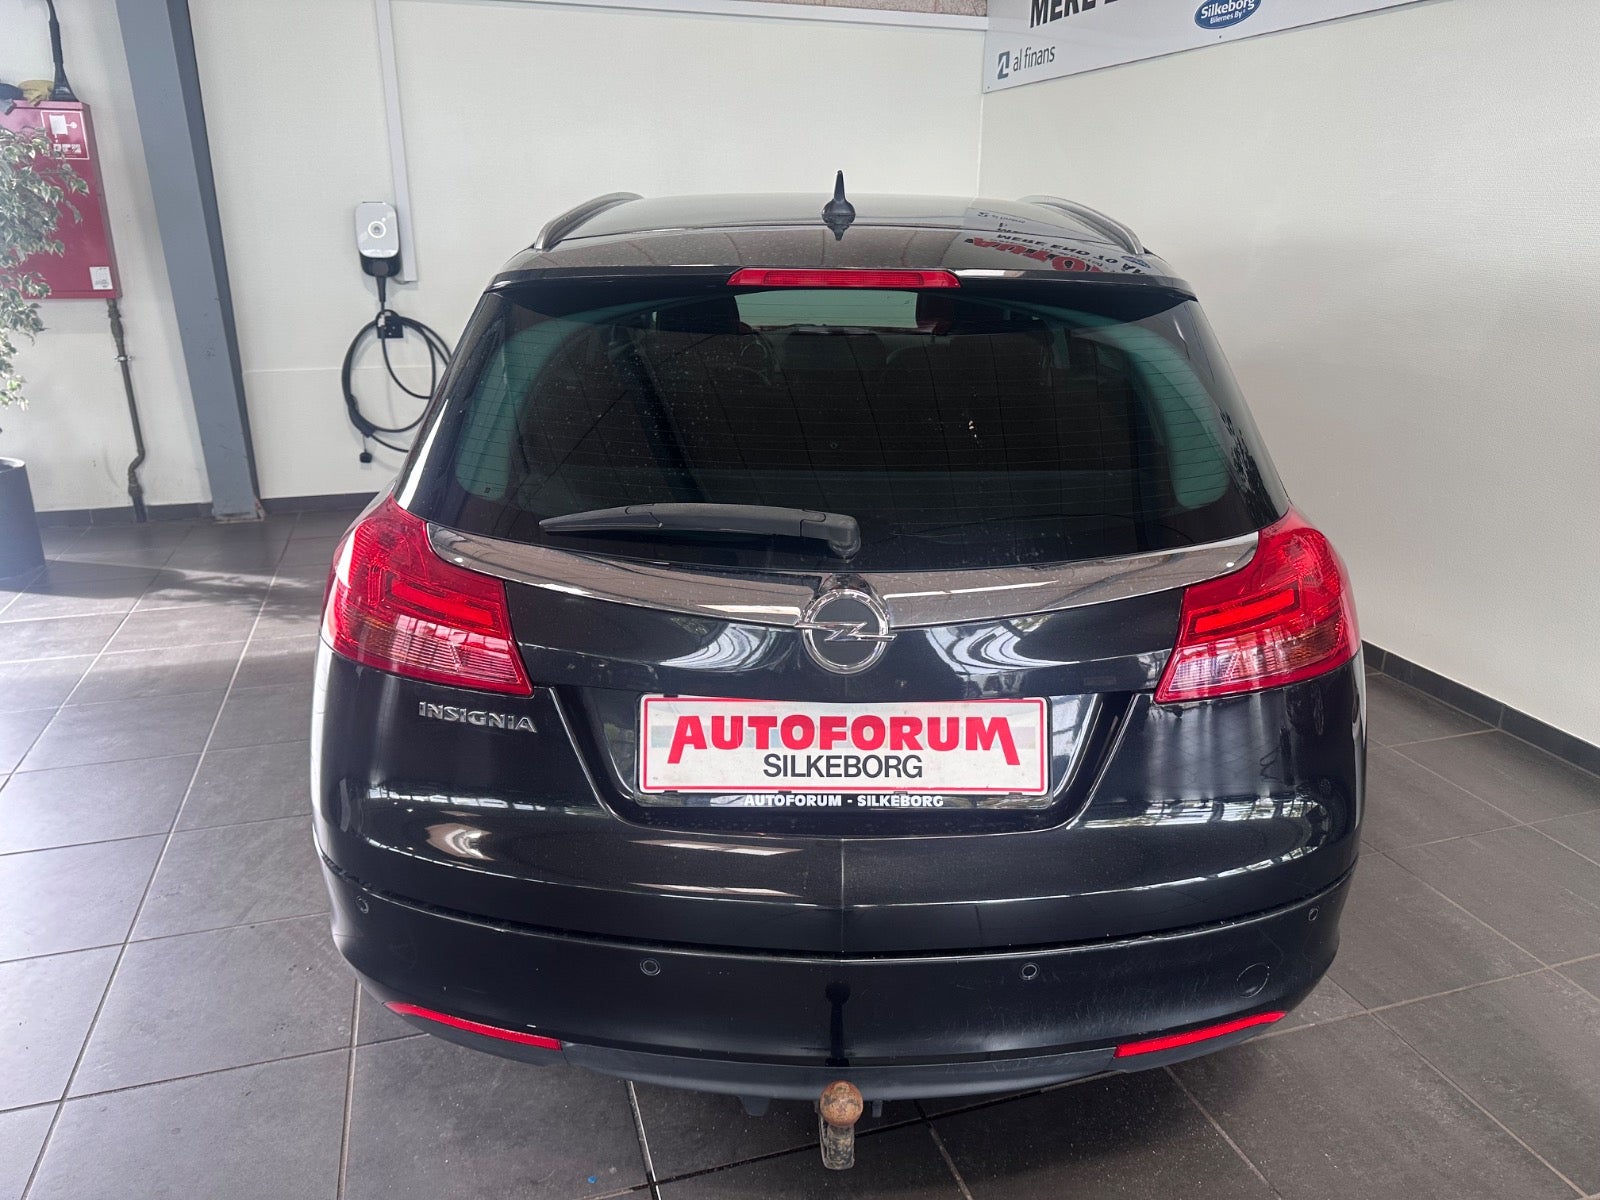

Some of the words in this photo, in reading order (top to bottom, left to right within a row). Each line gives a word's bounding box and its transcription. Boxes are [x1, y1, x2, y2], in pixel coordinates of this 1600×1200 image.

[1201, 0, 1255, 19] Silkeborg
[1234, 10, 1243, 19] By
[1013, 48, 1022, 72] al
[1024, 46, 1056, 69] finans
[419, 701, 537, 733] INSIGNIA
[667, 714, 1021, 765] AUTOFORUM
[763, 753, 923, 779] SILKEBORG
[744, 794, 842, 807] AUTOFORUM
[857, 794, 944, 808] SILKEBORG
